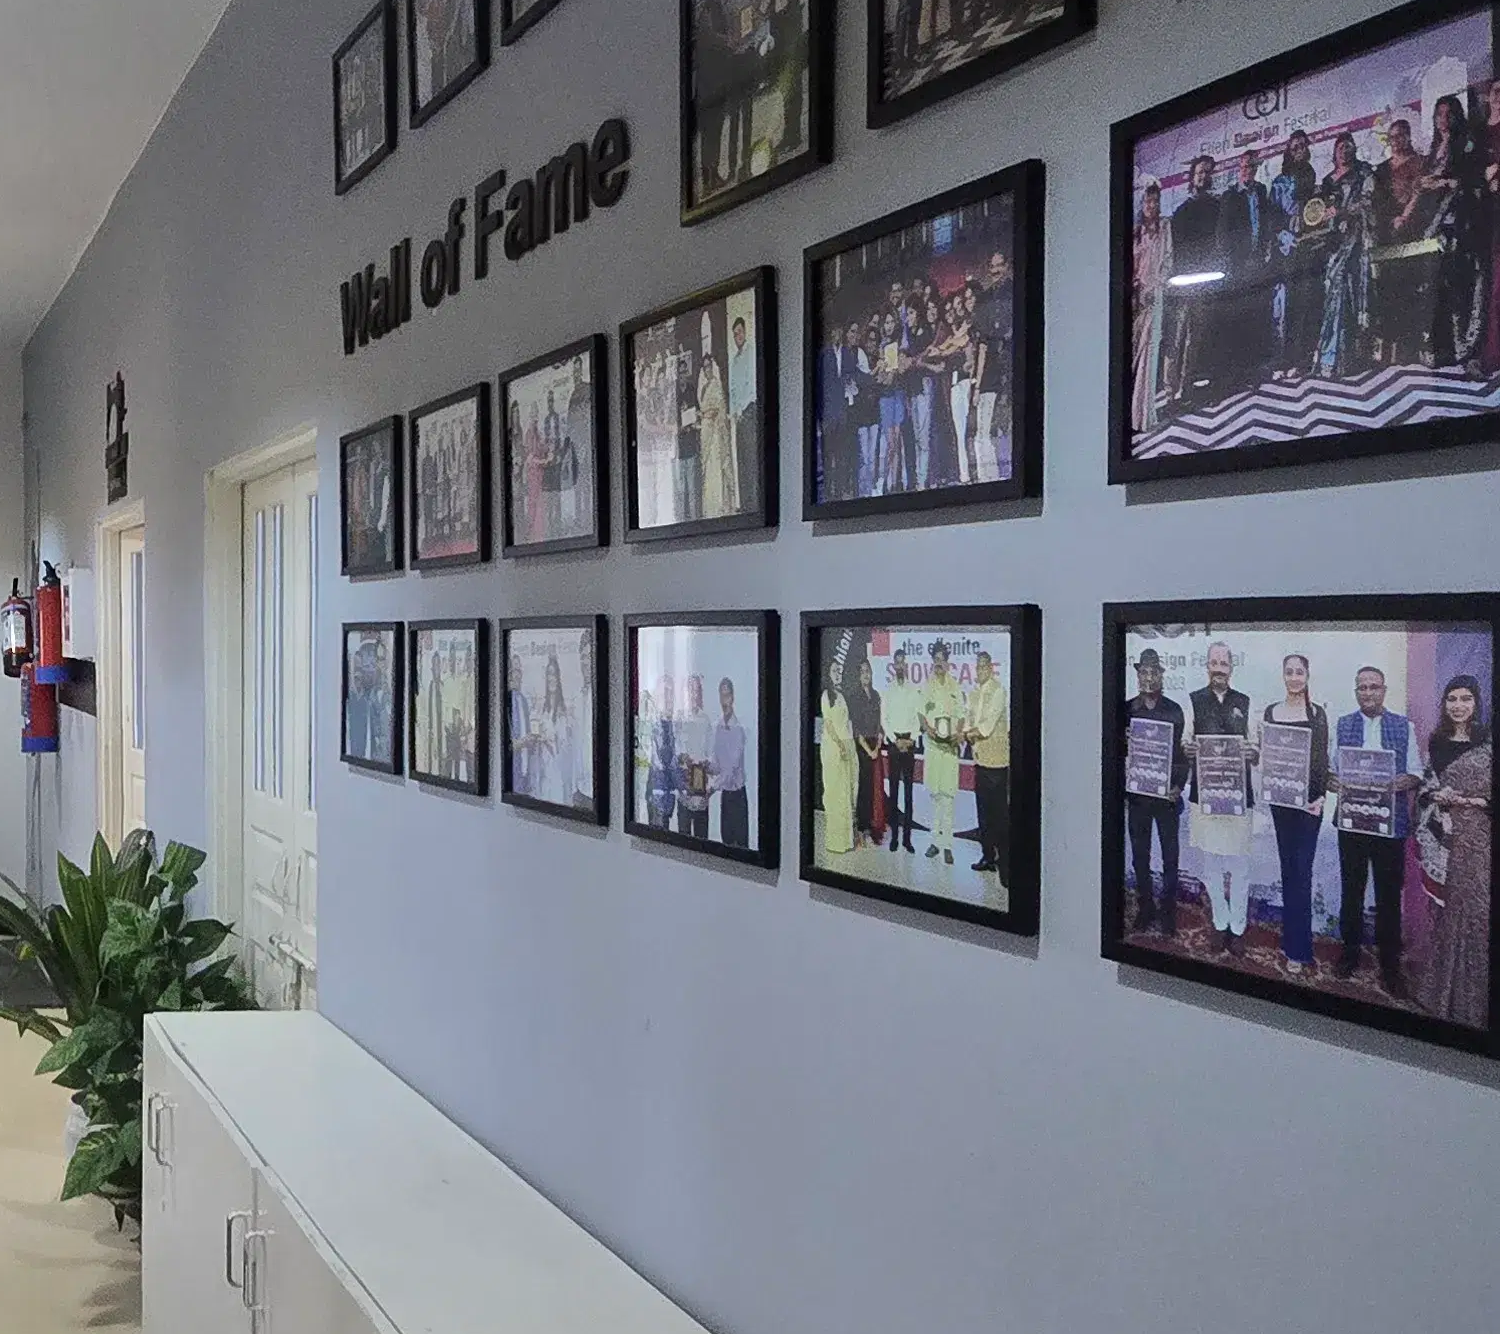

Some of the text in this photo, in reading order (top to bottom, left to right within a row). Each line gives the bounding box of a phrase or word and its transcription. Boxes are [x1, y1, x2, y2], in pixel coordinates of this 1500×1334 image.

[339, 118, 631, 355] Wall of Fame
[902, 638, 923, 656] the
